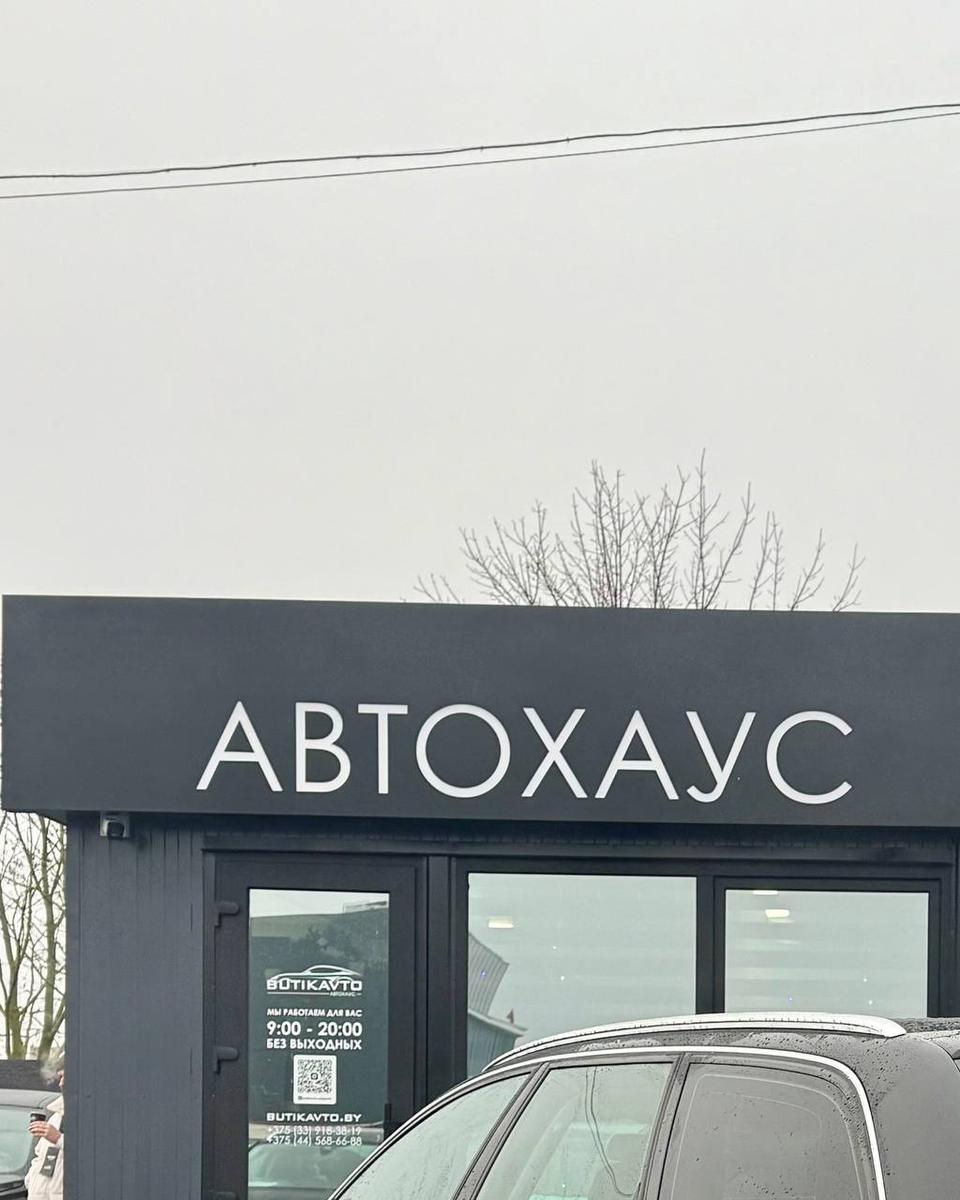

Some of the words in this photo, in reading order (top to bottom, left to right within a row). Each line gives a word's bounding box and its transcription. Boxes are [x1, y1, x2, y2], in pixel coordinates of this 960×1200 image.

[197, 700, 853, 804] АВТОХАУС
[266, 979, 363, 991] BUTIKAVTO
[267, 1008, 281, 1016] МЫ
[283, 1008, 326, 1016] РАБОТАЕМ
[326, 1009, 344, 1017] ДЛЯ
[345, 1009, 363, 1018] ВАС
[266, 1021, 301, 1035] 9:00
[317, 1021, 363, 1036] 20:00
[266, 1038, 287, 1049] БЕЗ
[289, 1038, 363, 1051] ВЫХОДНЫХ
[266, 1112, 362, 1122] BUTIKAVTO.BY
[293, 1135, 312, 1147] (44)
[314, 1136, 363, 1146] 568-66-88
